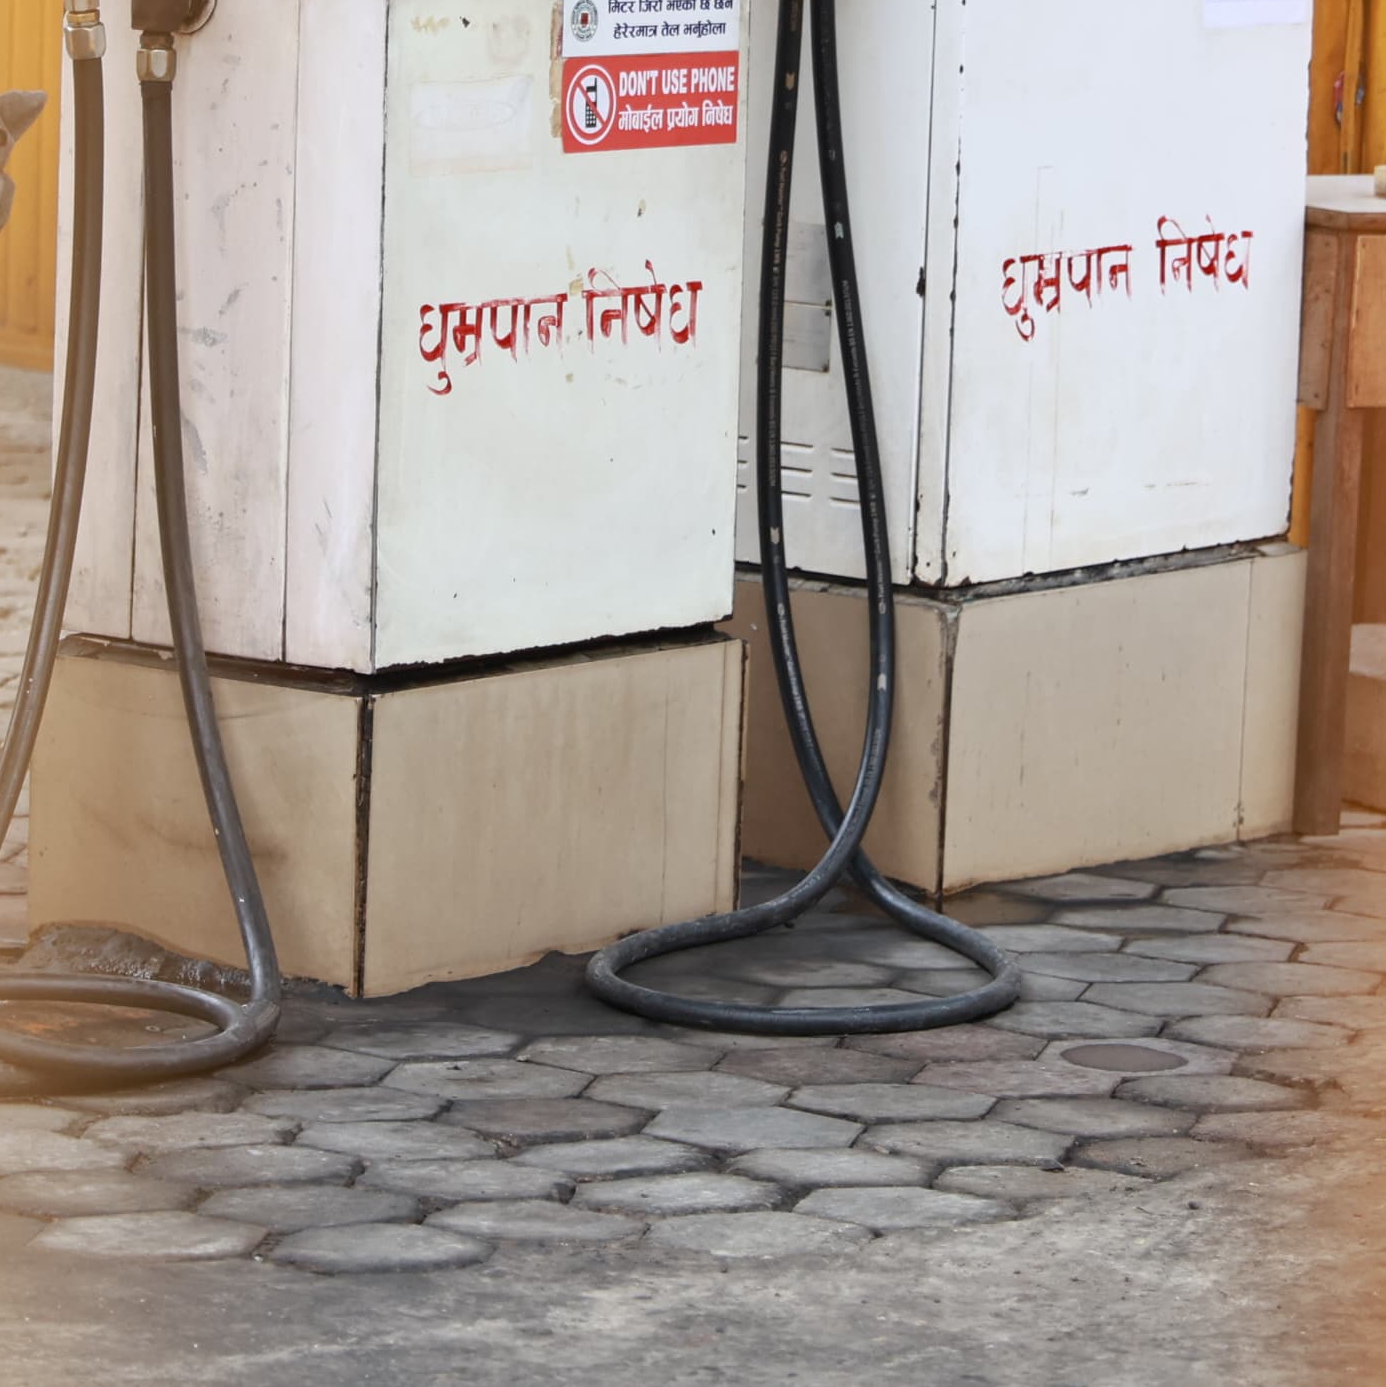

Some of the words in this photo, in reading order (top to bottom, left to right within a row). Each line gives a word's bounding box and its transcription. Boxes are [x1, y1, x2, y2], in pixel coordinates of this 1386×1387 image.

[700, 0, 711, 11] छ
[661, 21, 680, 36] तेल
[619, 70, 658, 97] DON'T
[662, 68, 688, 94] USE
[691, 66, 736, 93] PHONE
[666, 102, 700, 131] प्रयोग
[702, 99, 734, 127] निषेध
[1156, 214, 1254, 295] निषेध
[582, 259, 703, 352] निषेध
